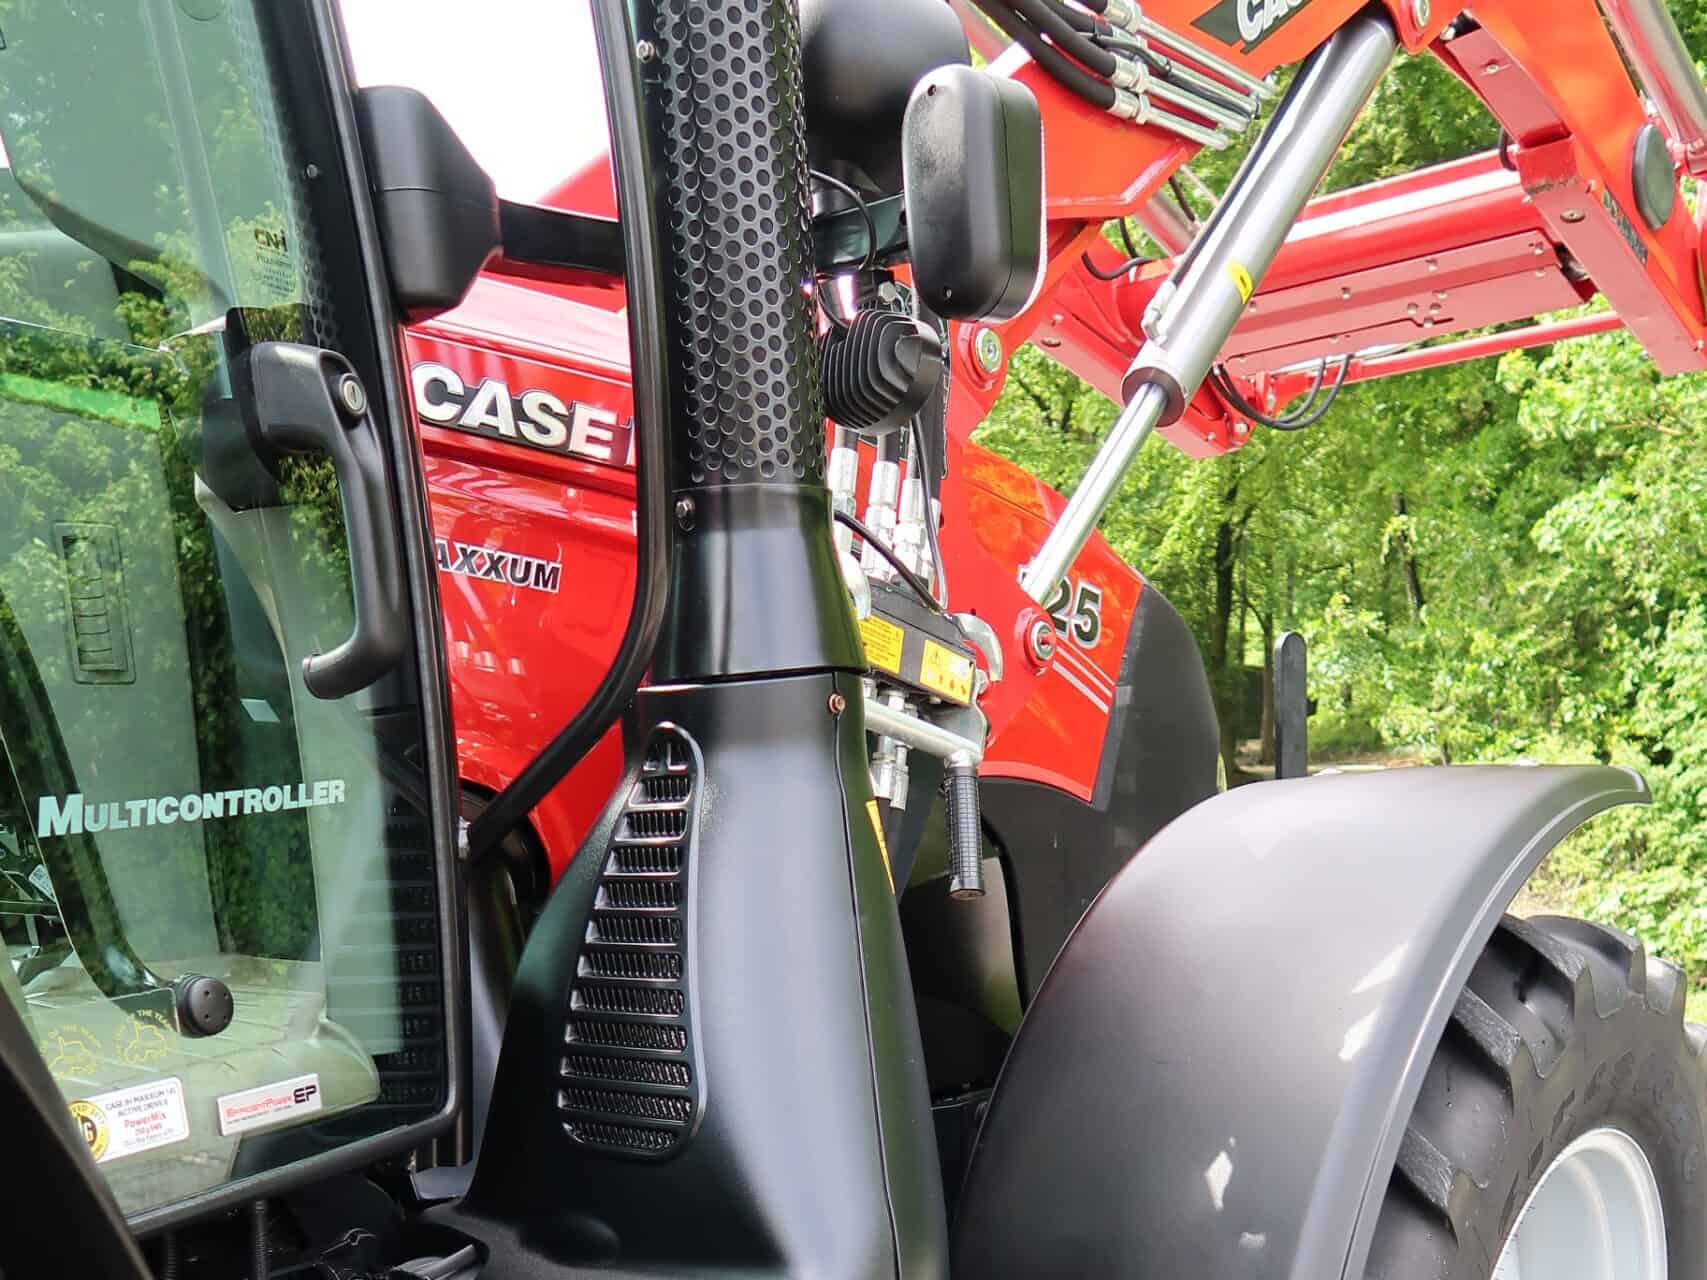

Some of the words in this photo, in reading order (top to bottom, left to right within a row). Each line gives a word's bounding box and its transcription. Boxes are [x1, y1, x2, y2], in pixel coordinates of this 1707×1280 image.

[411, 362, 618, 461] CASE
[435, 539, 562, 593] AXXUM
[1044, 576, 1102, 649] 25
[293, 1084, 317, 1105] EP
